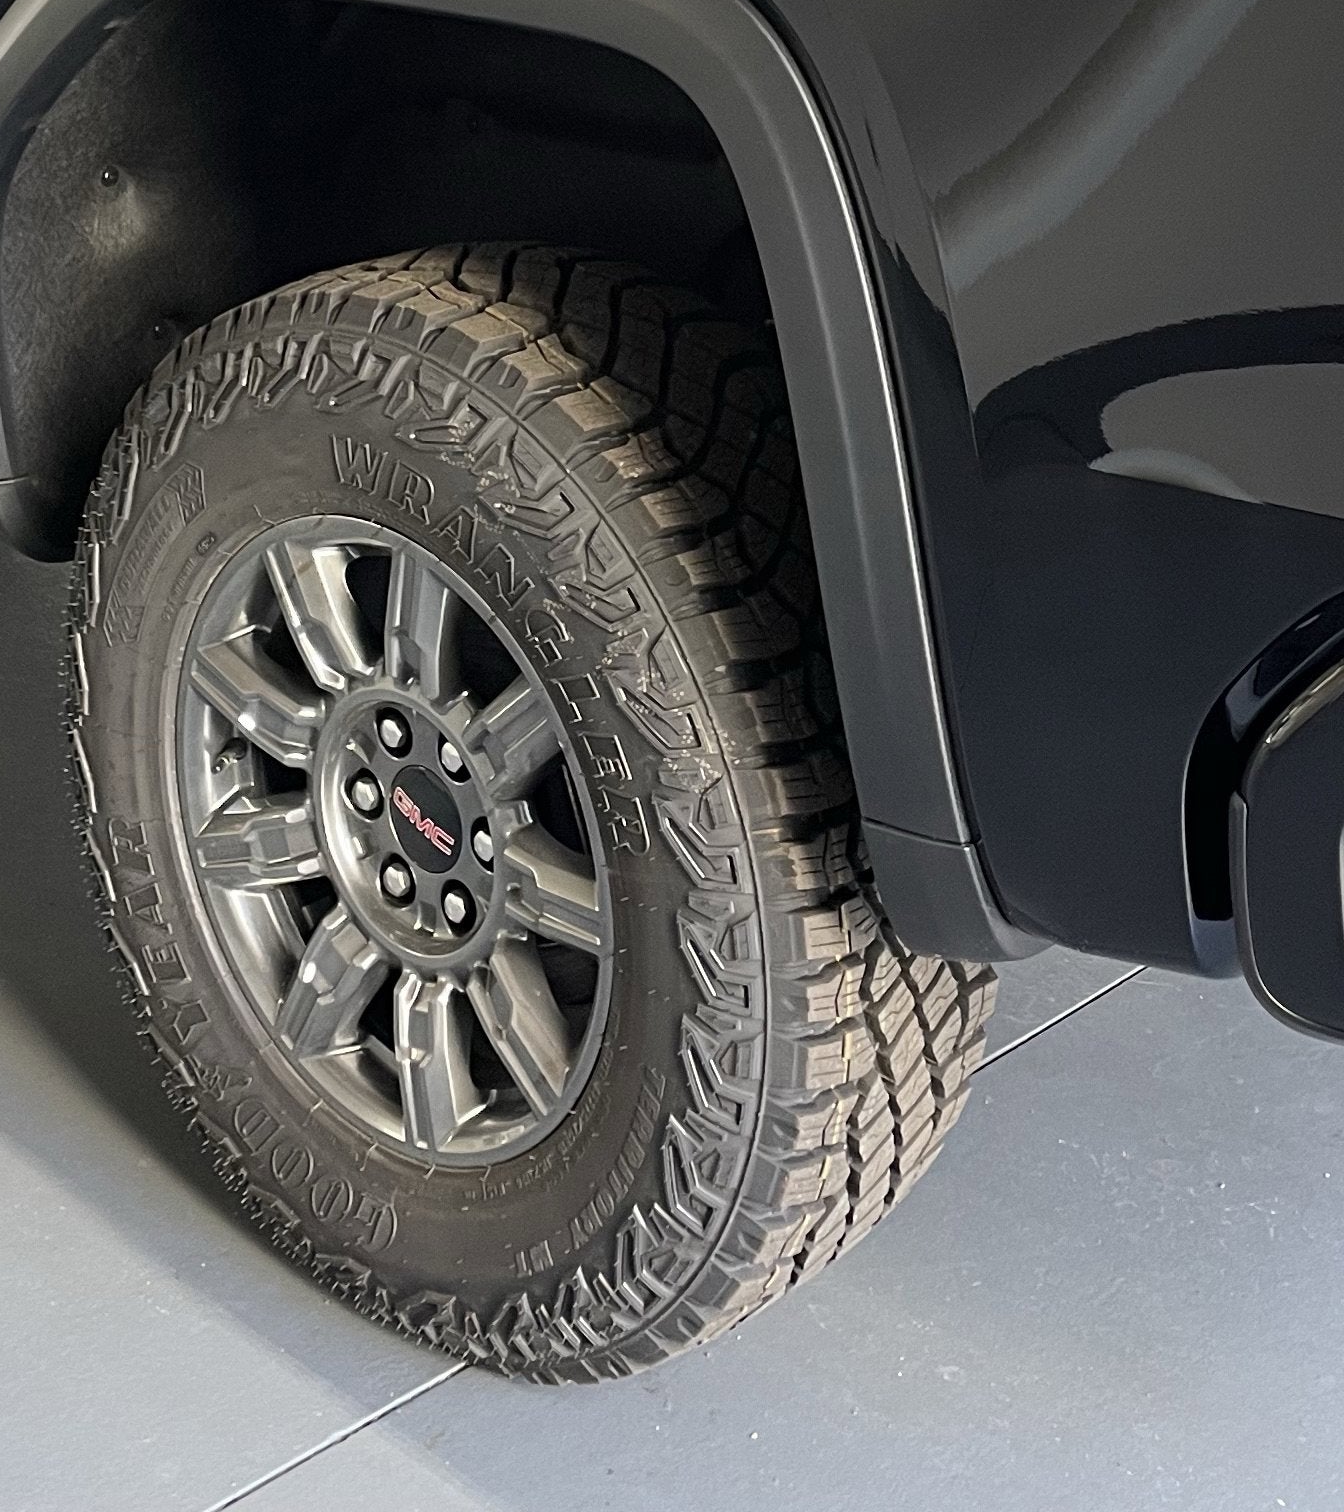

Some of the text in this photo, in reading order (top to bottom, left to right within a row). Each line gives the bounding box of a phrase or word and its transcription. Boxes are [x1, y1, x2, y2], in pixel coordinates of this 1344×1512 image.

[330, 432, 651, 857] WRANGLER
[393, 786, 455, 856] GMC
[569, 1062, 666, 1251] TERRITORY
